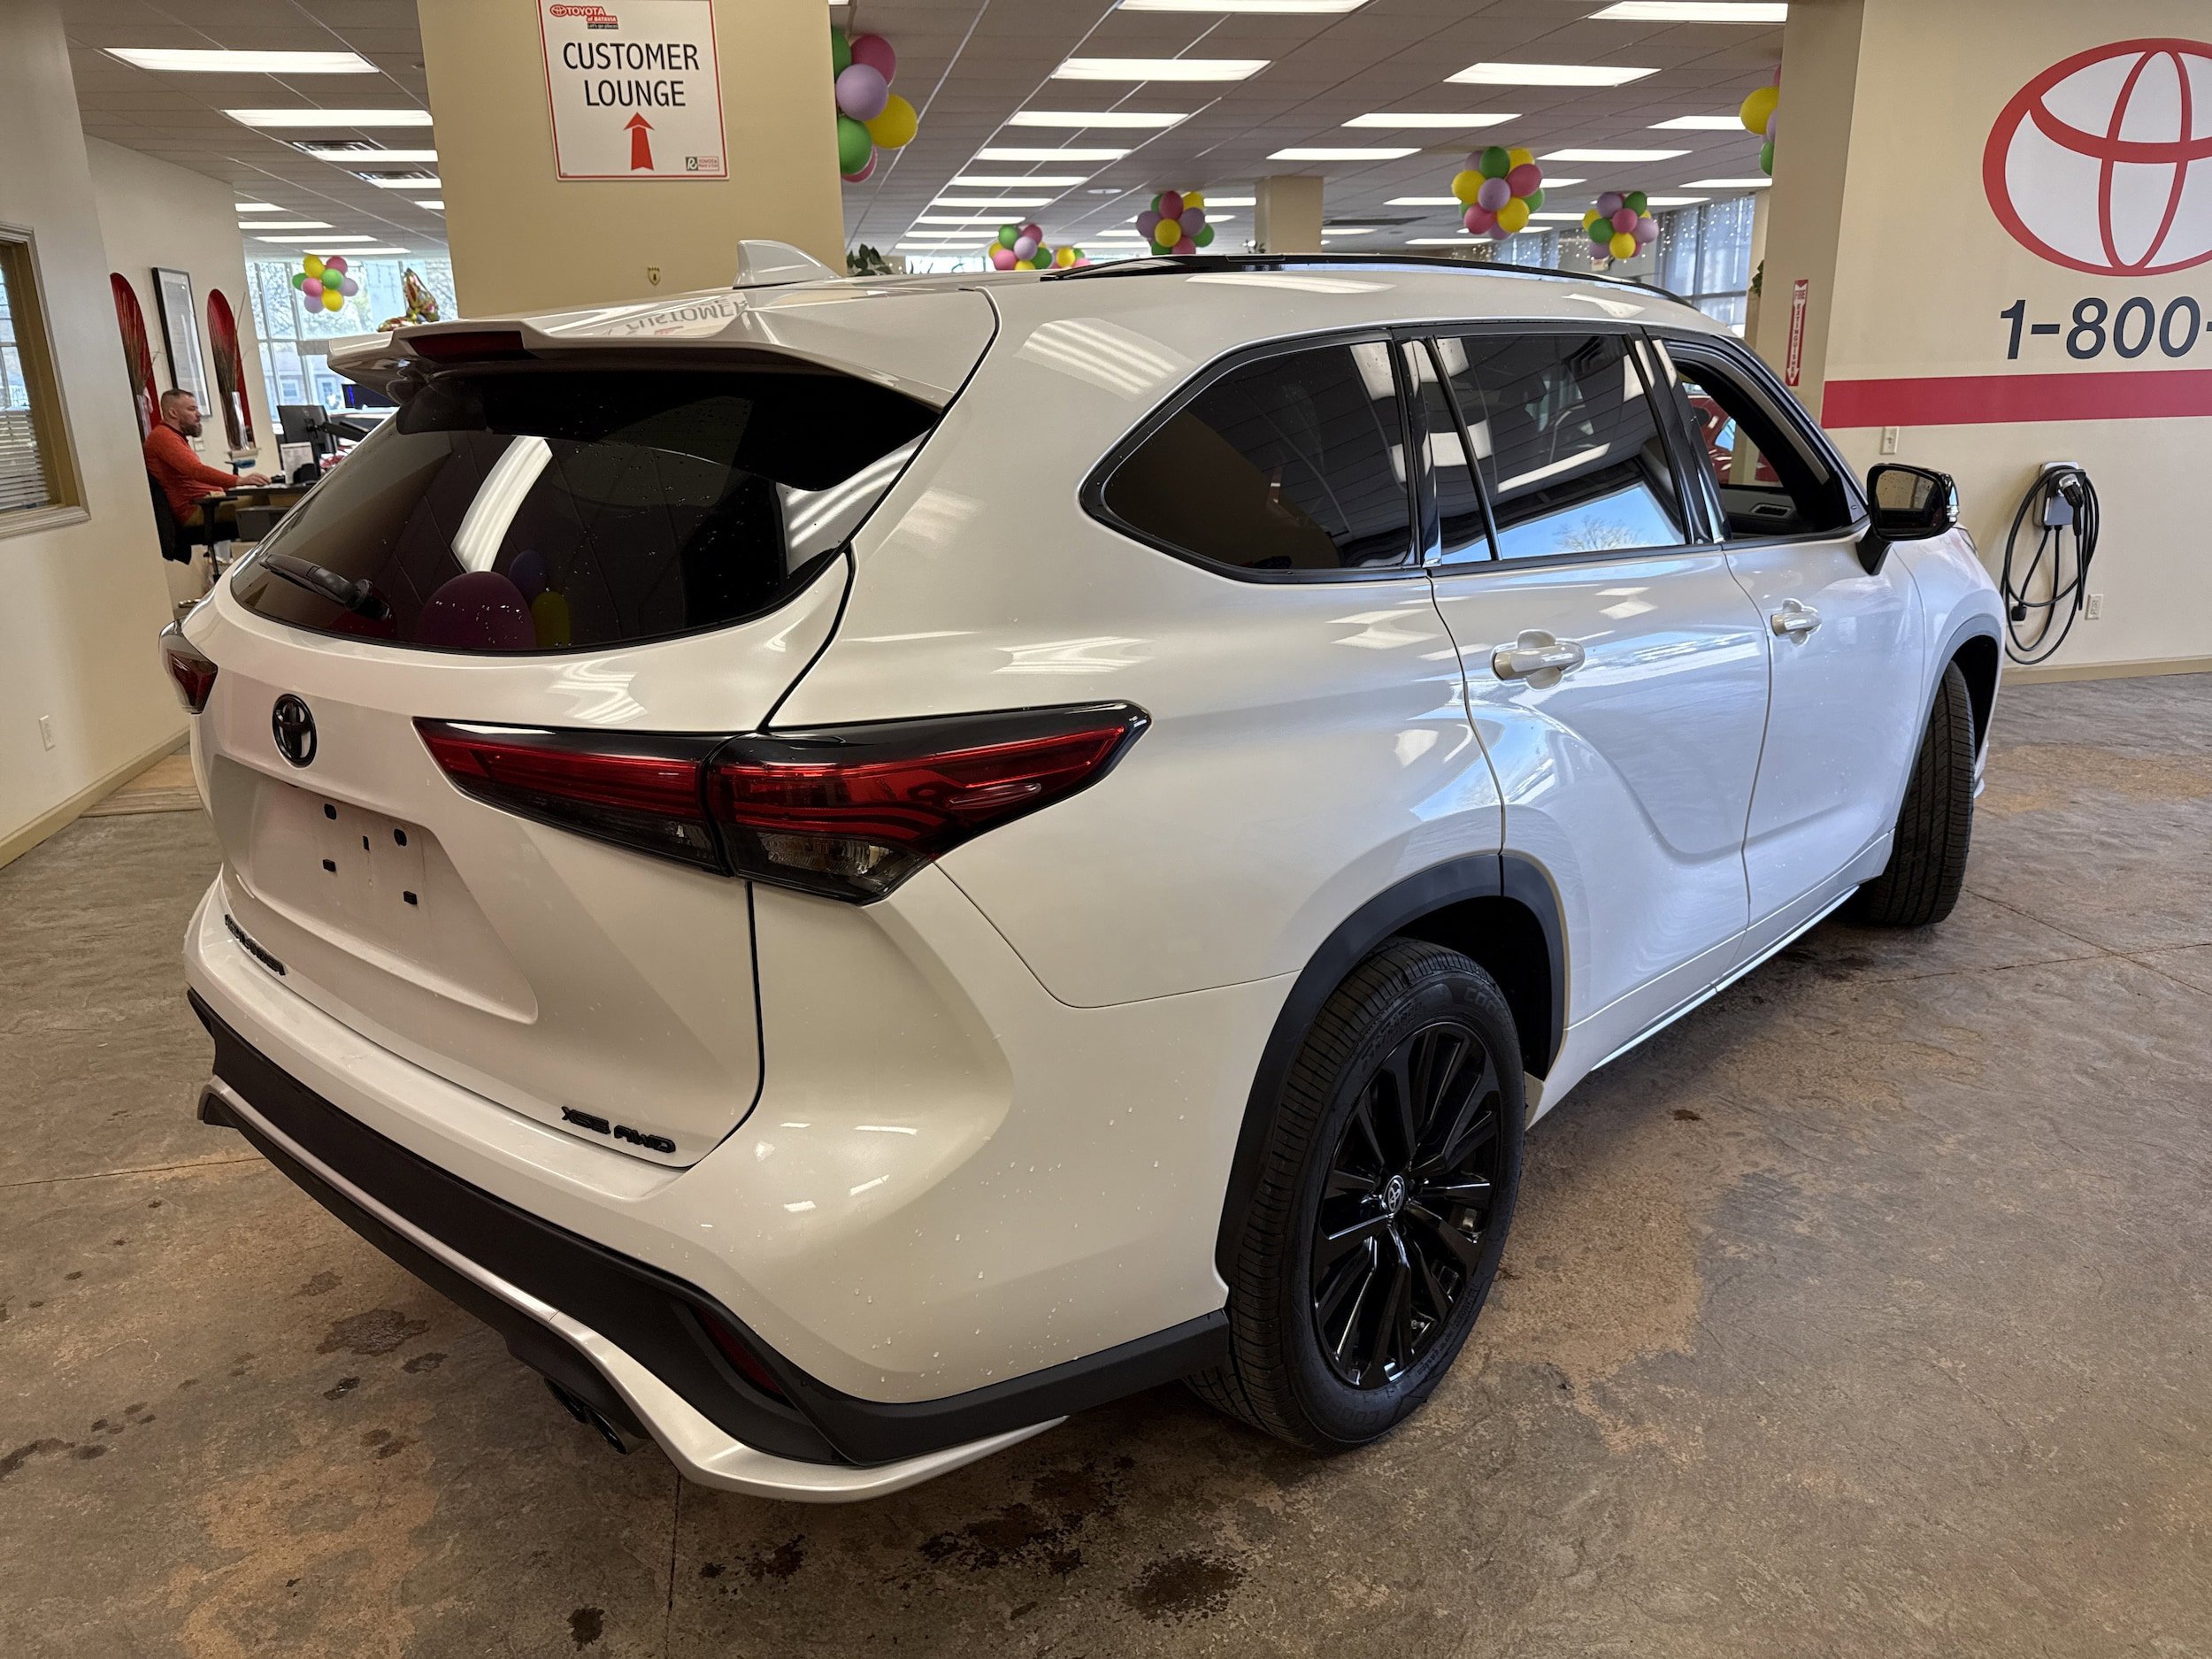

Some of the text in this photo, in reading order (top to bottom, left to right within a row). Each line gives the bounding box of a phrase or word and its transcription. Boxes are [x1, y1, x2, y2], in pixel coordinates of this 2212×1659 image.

[566, 7, 605, 16] TOYOTA
[563, 42, 700, 70] CUSTOMER
[584, 80, 686, 107] LOUNGE
[2000, 295, 2212, 360] 1-800
